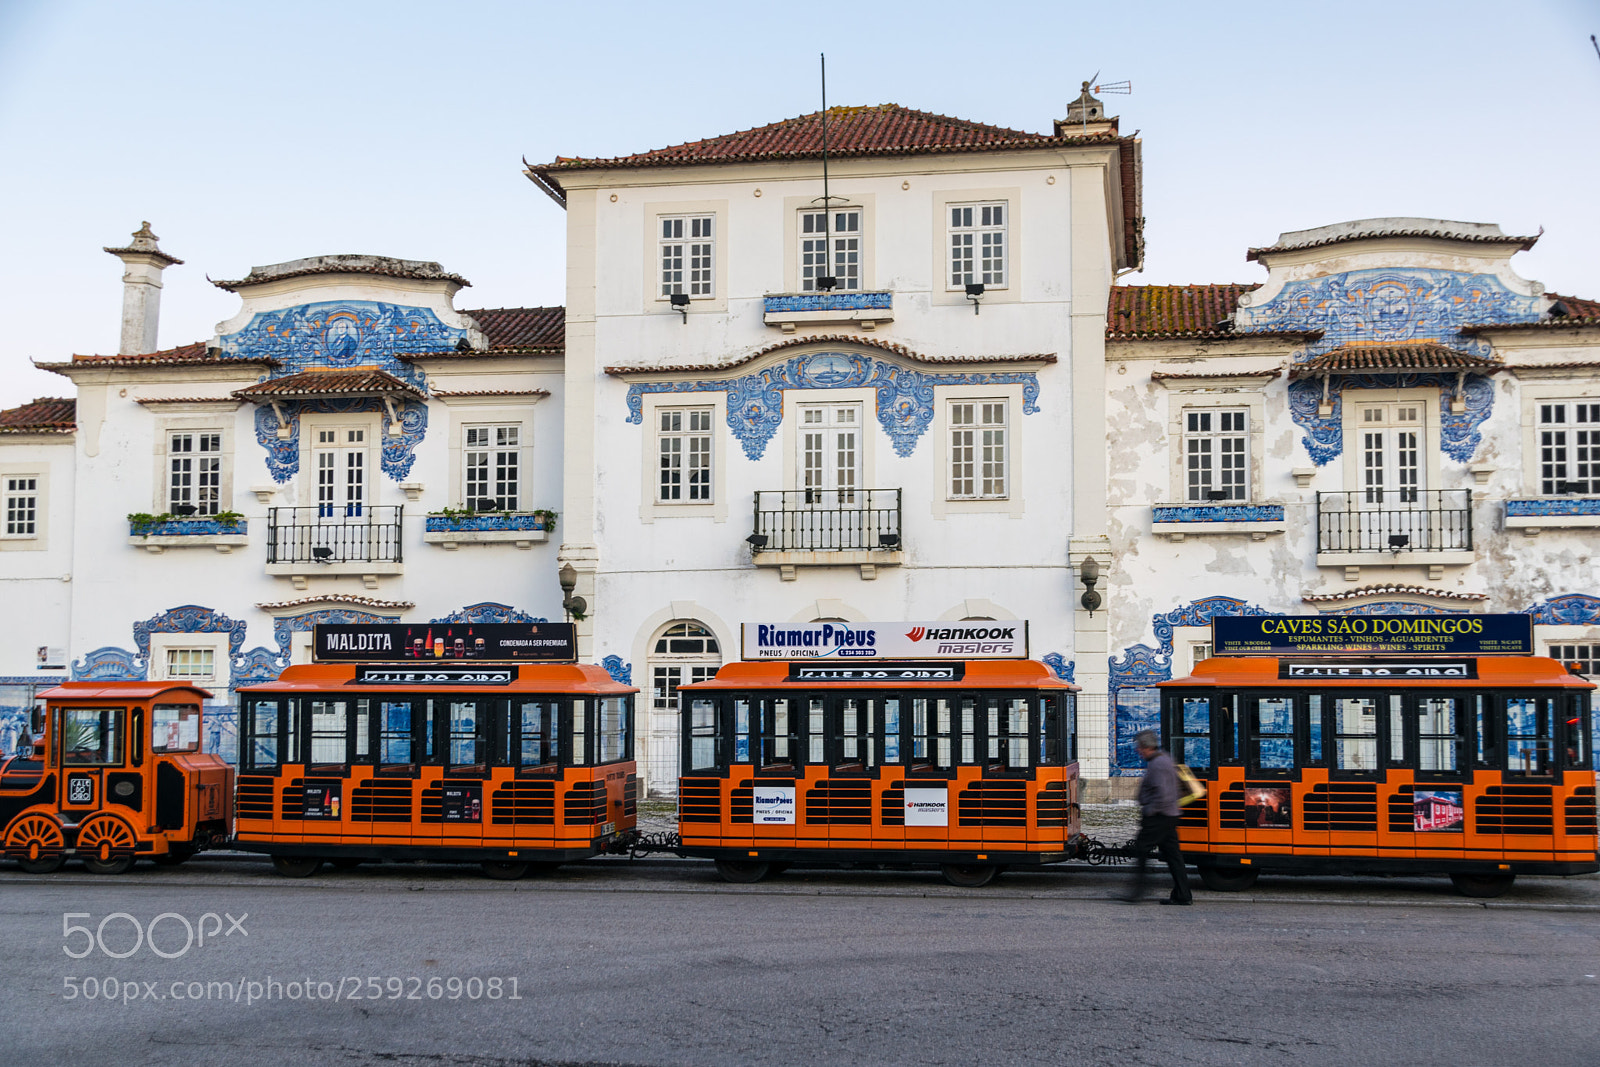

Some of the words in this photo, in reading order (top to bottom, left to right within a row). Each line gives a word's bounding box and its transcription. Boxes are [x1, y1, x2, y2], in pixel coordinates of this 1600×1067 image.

[1261, 619, 1323, 634] CAVES
[1327, 615, 1368, 634] SÃO
[1372, 619, 1483, 634] DOMINGOS
[326, 633, 392, 650] MALDITA
[758, 624, 876, 647] RiamarPneus
[1288, 635, 1344, 643] ESPUMANTES
[1350, 635, 1384, 643] VINHOS
[1390, 635, 1454, 643] AGUARDENTES
